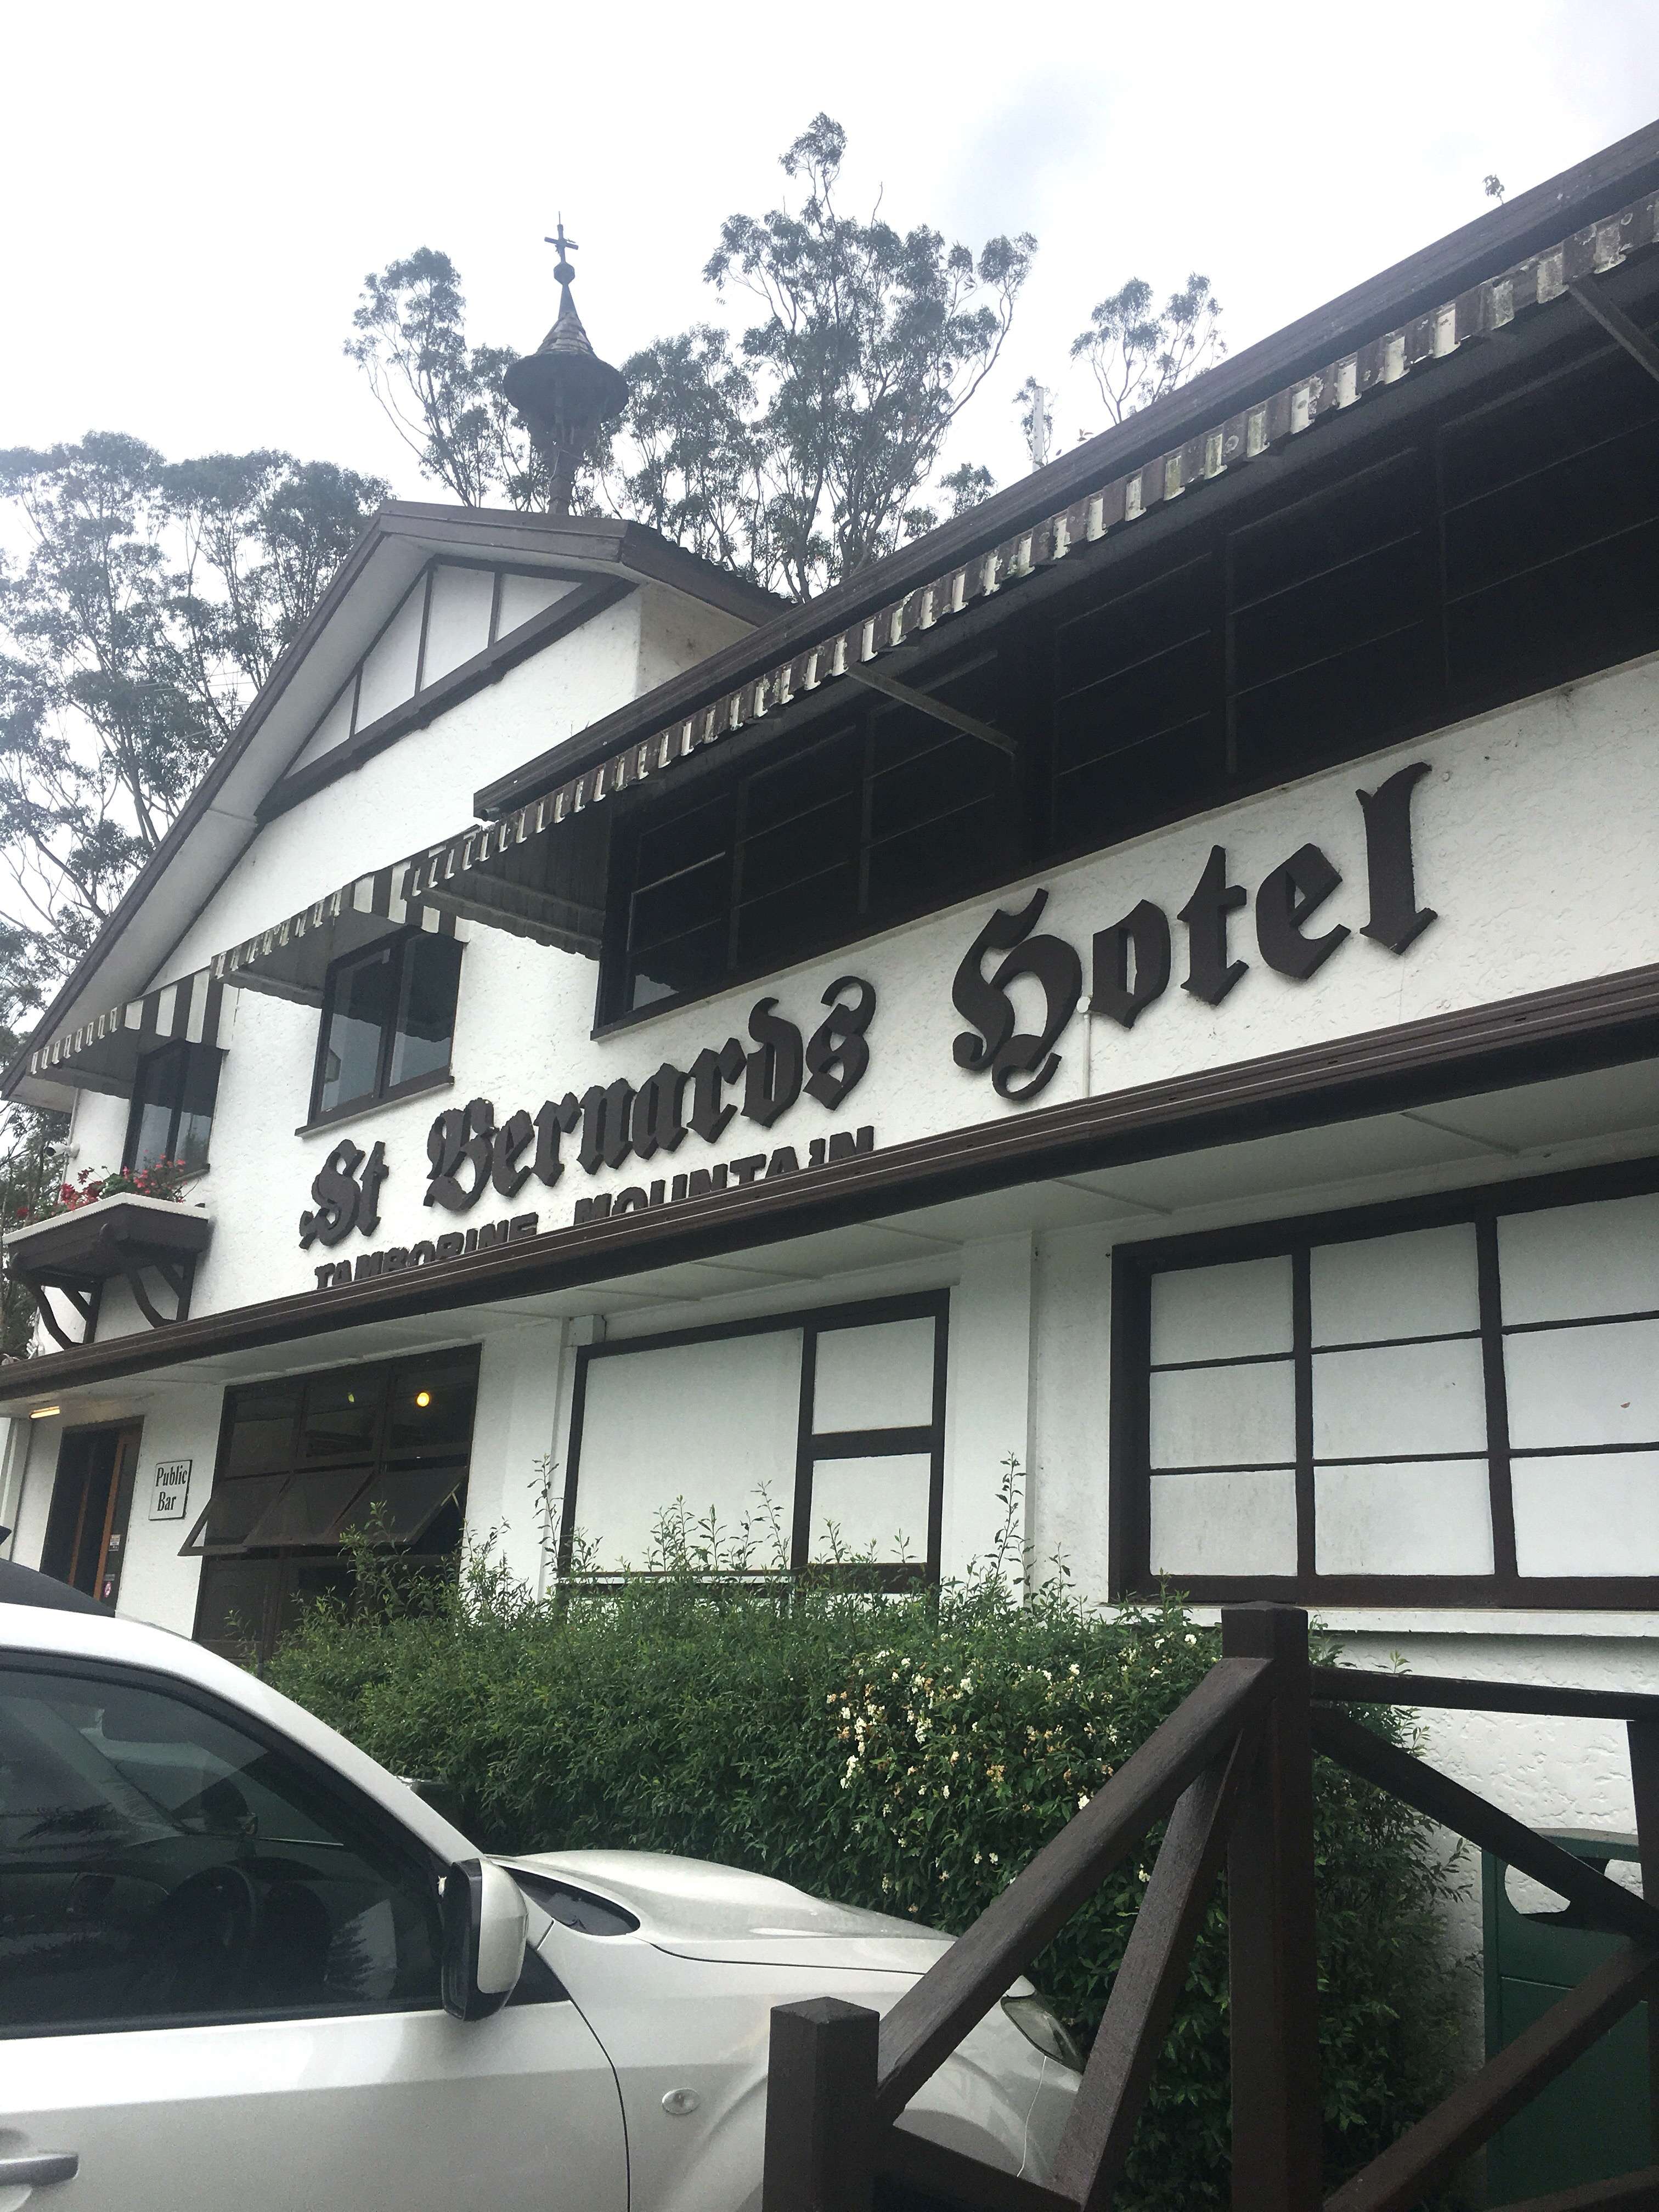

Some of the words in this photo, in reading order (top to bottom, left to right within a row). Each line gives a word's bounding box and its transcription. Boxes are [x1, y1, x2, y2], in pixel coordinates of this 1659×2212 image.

[299, 1139, 389, 1250] St
[952, 761, 1438, 1099] Hotel
[155, 1465, 187, 1487] Public
[157, 1491, 177, 1511] Bar
